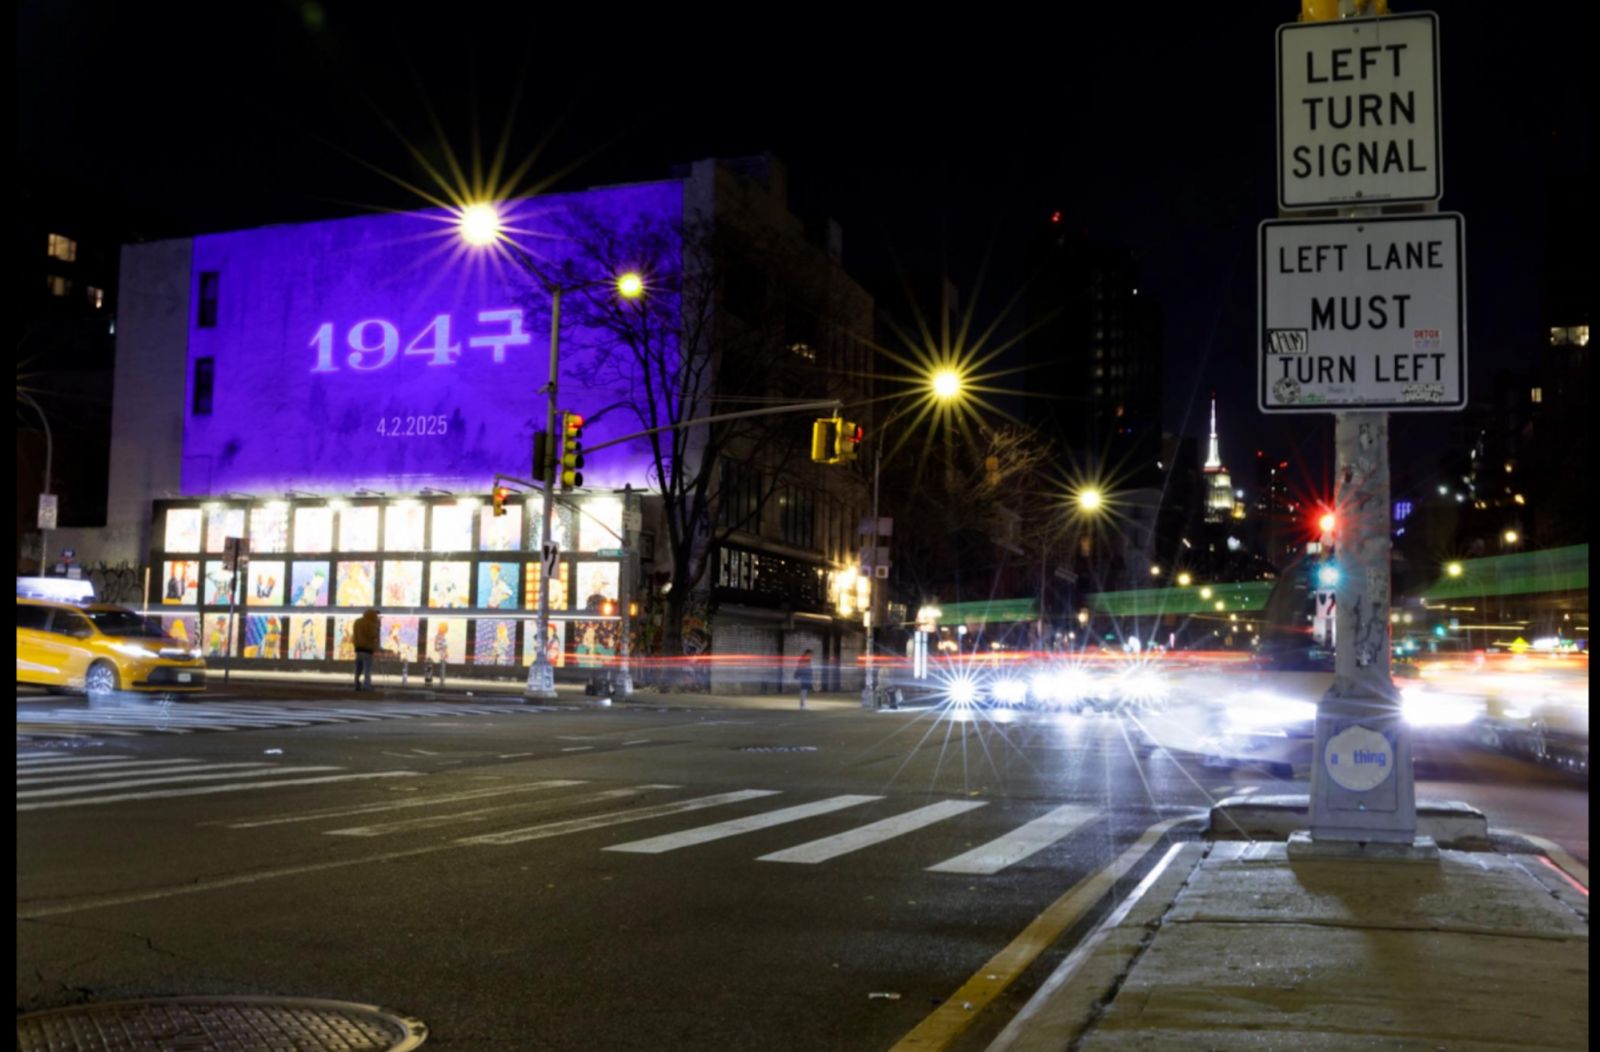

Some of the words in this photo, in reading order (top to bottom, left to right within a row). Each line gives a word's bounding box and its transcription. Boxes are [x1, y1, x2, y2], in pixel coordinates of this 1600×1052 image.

[1307, 43, 1408, 84] LEFT
[1302, 91, 1415, 131] TURN
[1292, 139, 1427, 179] SIGNAL
[1279, 244, 1348, 274] LEFT
[1366, 241, 1443, 271] LANE
[1311, 294, 1411, 331] MUST
[1279, 355, 1356, 384] TURN
[1375, 353, 1446, 383] LEFT
[376, 414, 448, 437] 4.2.2025
[1330, 752, 1339, 765] a
[1353, 749, 1386, 767] thing
